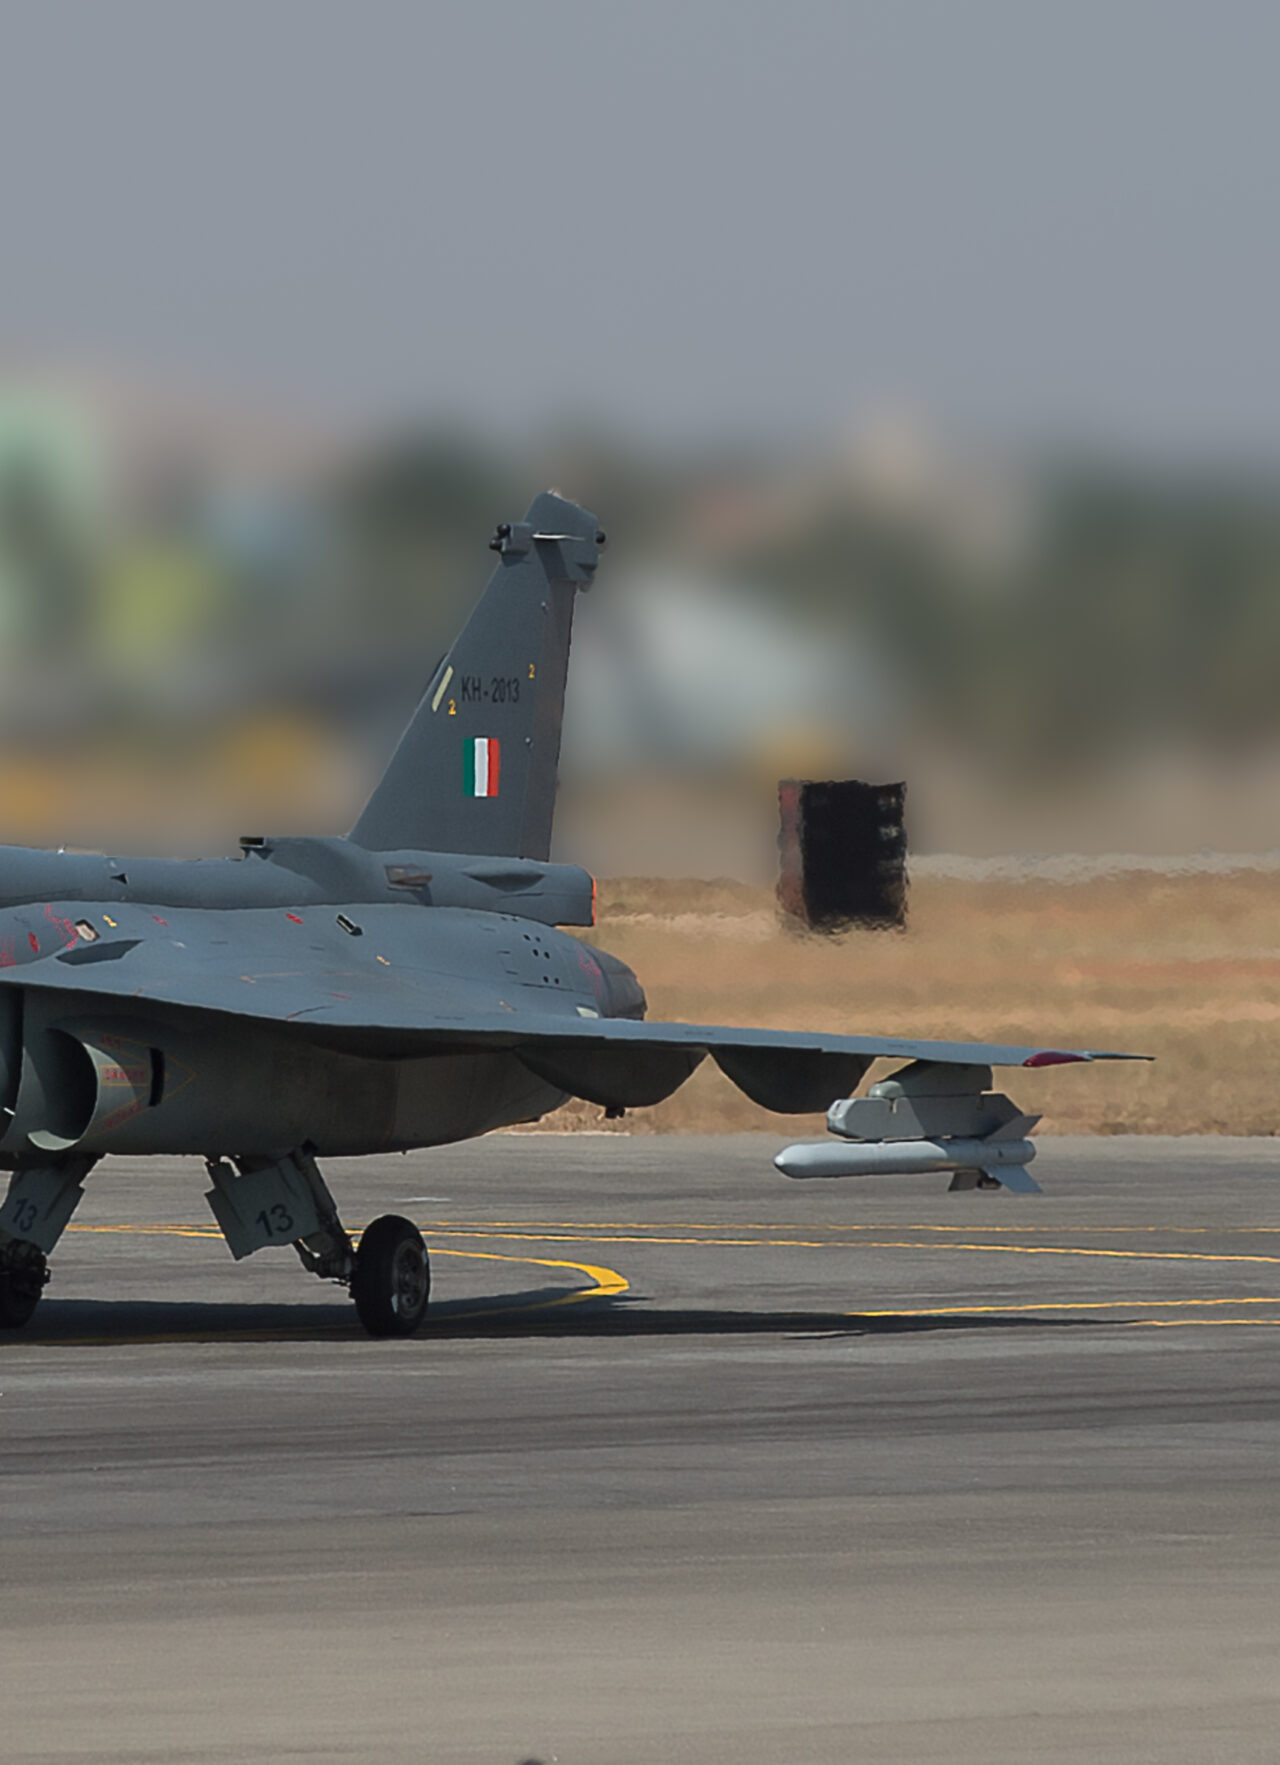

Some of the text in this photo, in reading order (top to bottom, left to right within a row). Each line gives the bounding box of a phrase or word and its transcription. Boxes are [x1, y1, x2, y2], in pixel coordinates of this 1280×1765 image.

[528, 664, 536, 679] 2
[448, 698, 457, 715] 2
[12, 1198, 38, 1232] 13
[256, 1203, 294, 1237] 13
